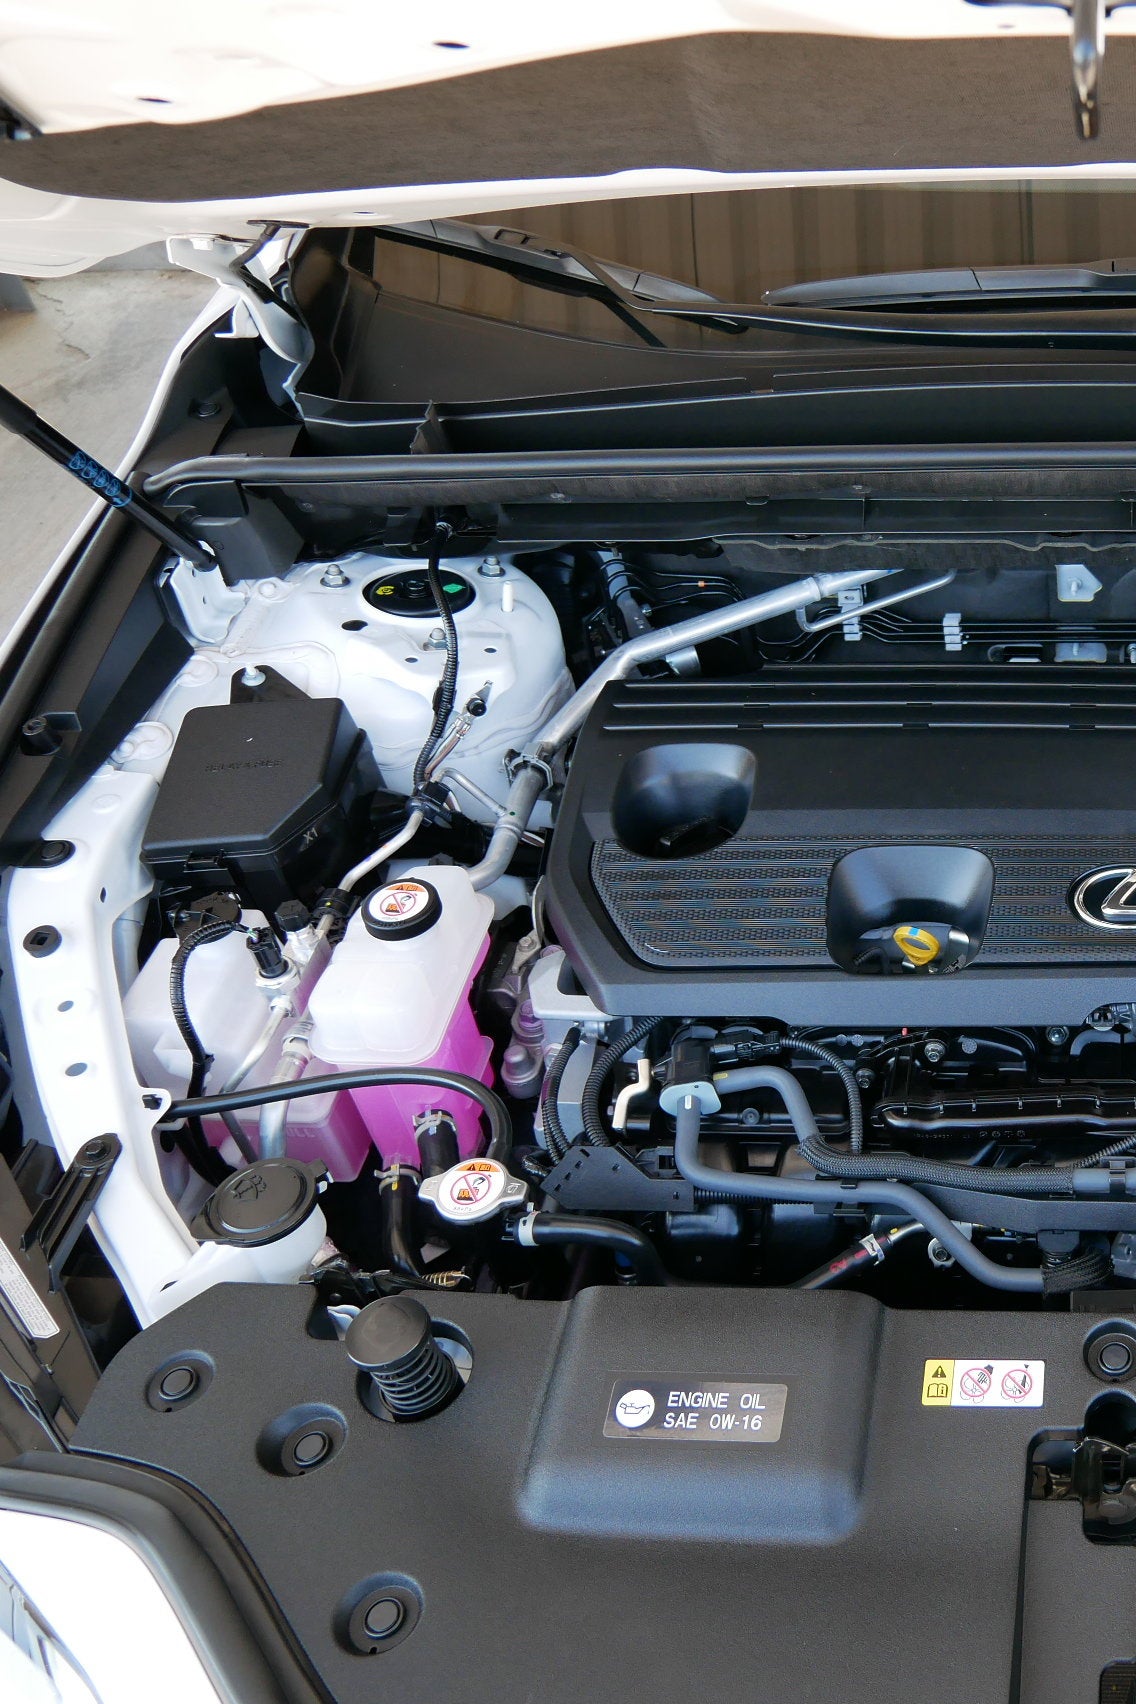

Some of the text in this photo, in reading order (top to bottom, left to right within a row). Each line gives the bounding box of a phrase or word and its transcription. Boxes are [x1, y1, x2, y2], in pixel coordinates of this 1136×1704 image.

[667, 1390, 766, 1410] ENGINE OIL
[664, 1412, 763, 1431] SAE 0W-16
